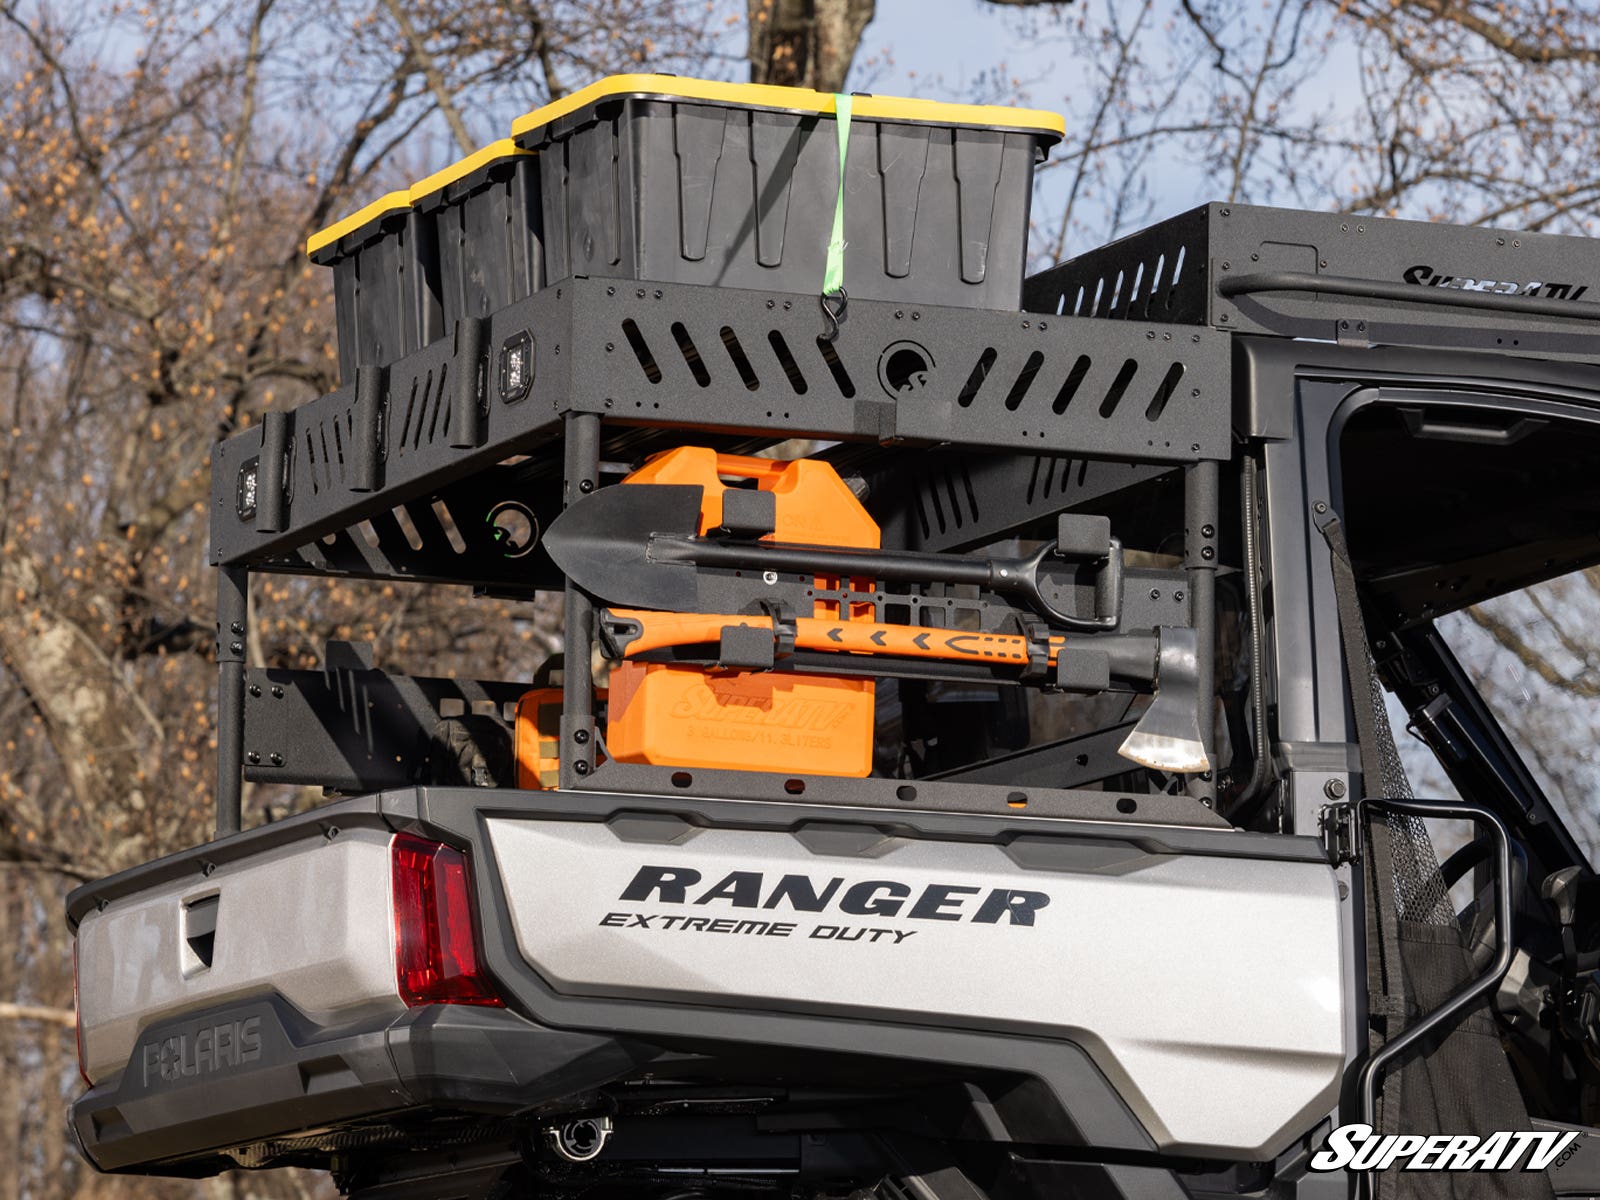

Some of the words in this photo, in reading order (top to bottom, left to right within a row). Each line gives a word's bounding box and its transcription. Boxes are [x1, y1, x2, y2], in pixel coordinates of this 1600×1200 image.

[619, 865, 1051, 926] RANGER
[599, 912, 798, 938] EXTREME
[808, 924, 918, 944] DUTY
[143, 1015, 262, 1088] POLARIS
